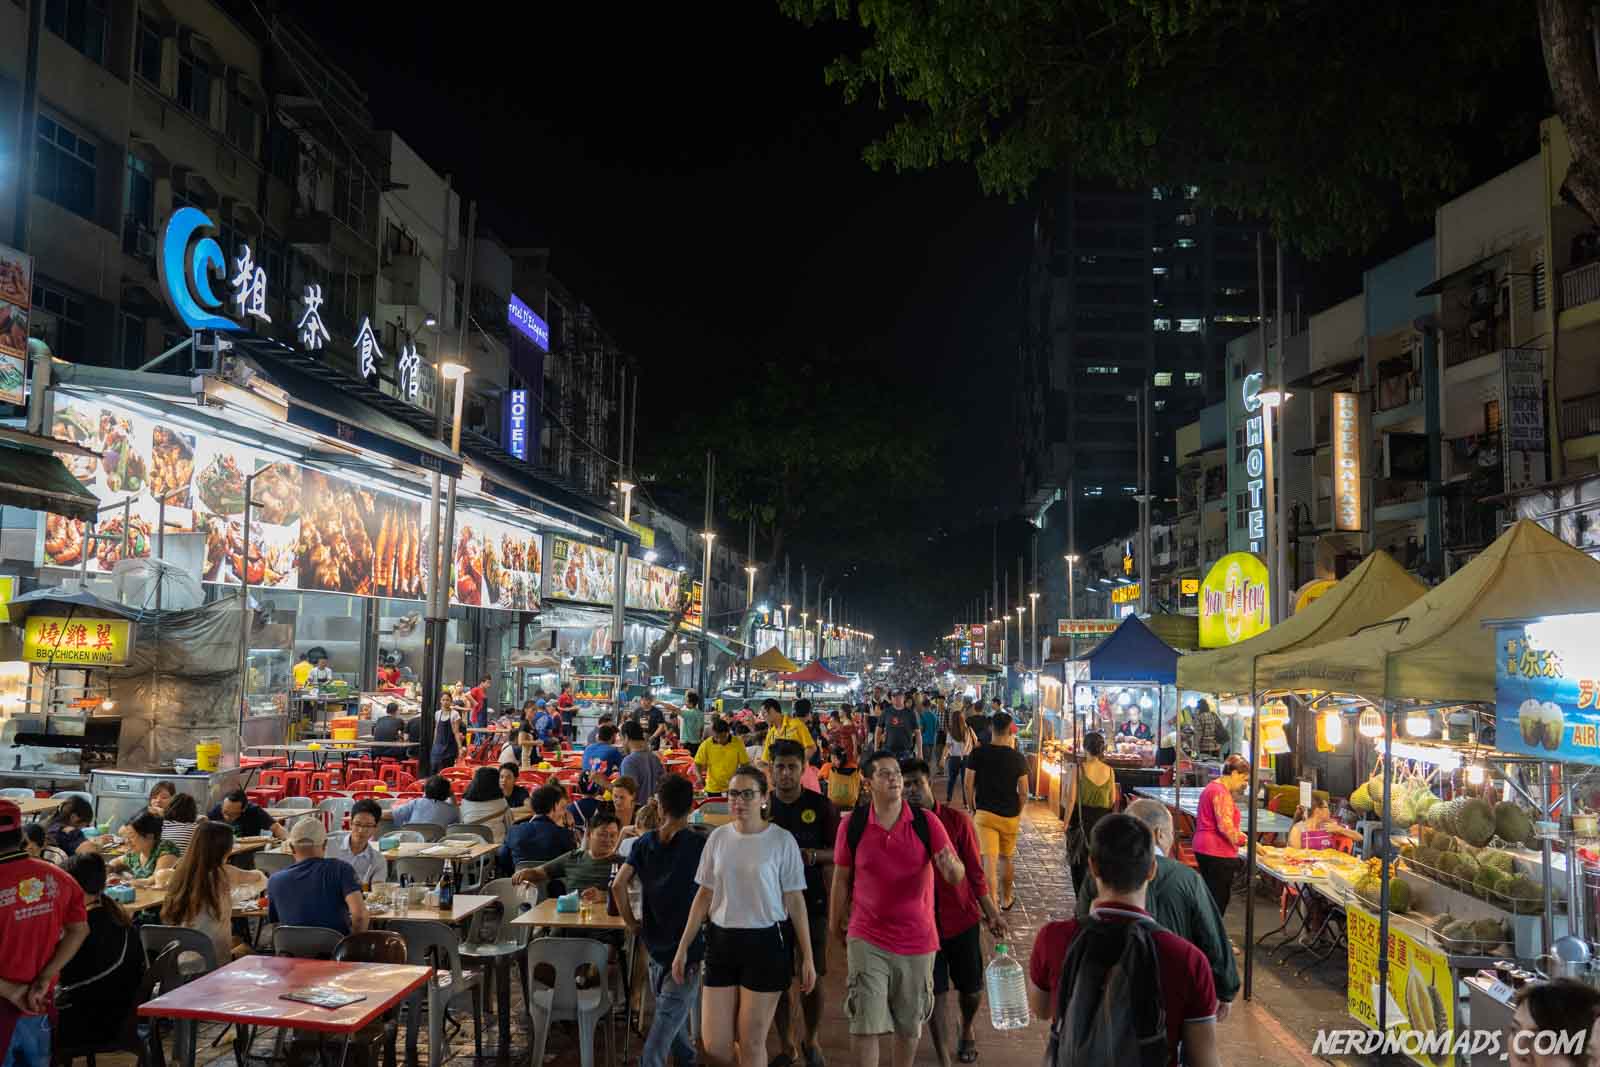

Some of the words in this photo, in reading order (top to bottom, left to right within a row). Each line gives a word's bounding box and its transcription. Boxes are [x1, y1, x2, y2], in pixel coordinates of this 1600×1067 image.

[511, 391, 526, 453] HOTEL
[36, 648, 52, 658] BBQ
[55, 649, 90, 660] CHICKEN
[91, 651, 113, 662] WING
[1573, 725, 1596, 746] AIR
